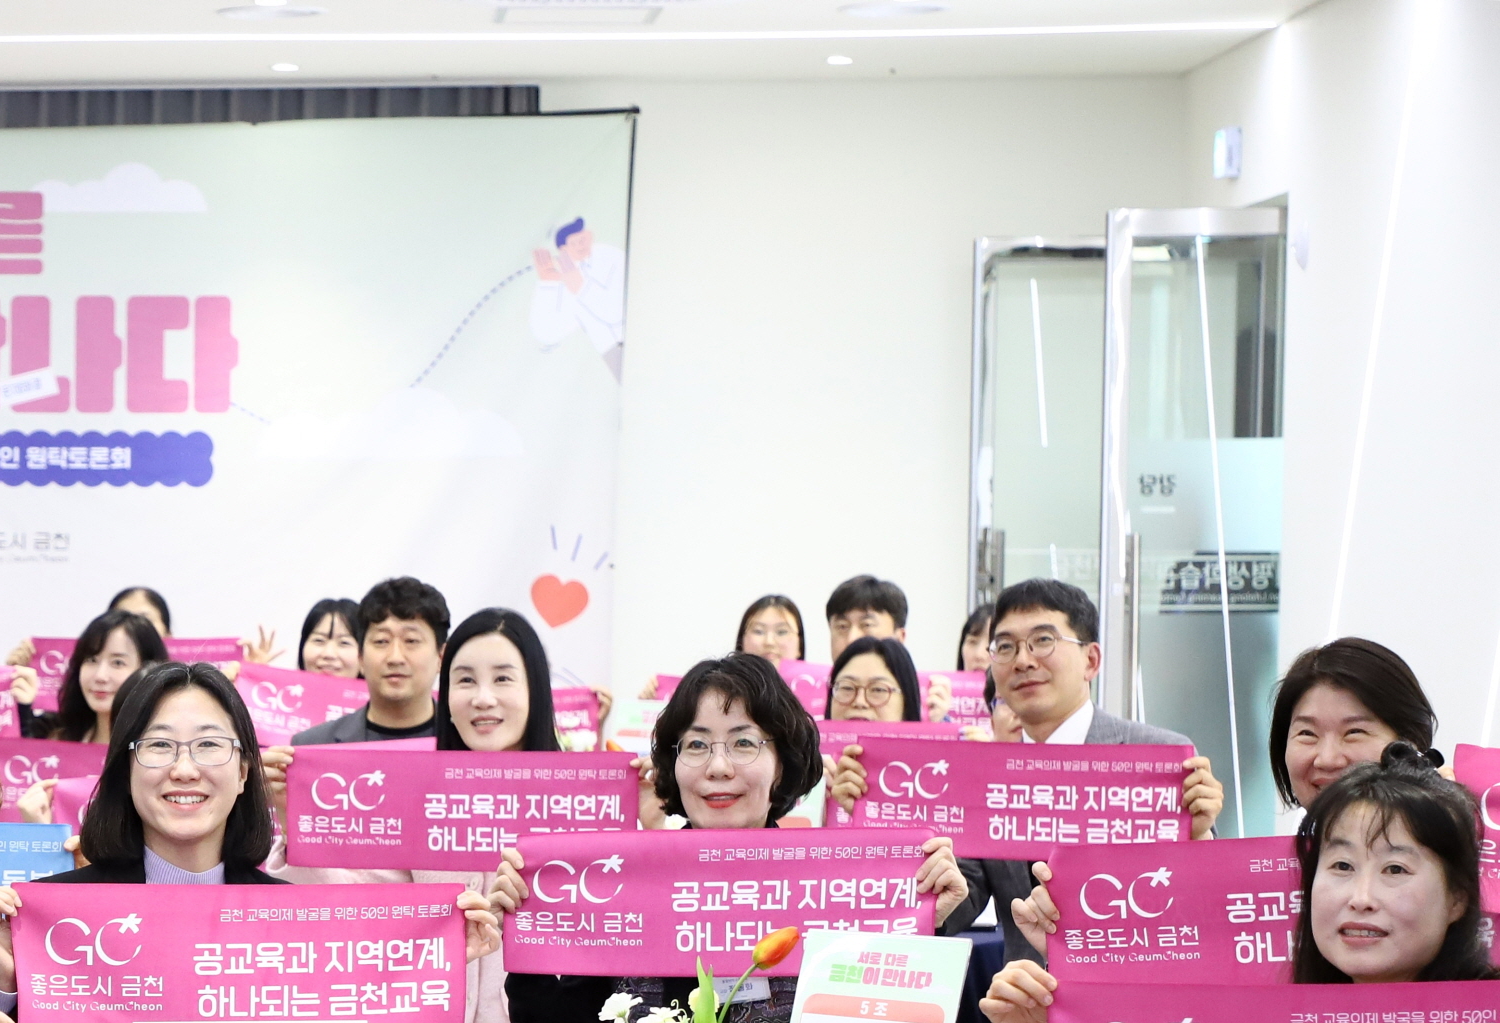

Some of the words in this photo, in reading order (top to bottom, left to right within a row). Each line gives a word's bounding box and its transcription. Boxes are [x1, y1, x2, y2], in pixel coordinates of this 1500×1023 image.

[26, 446, 132, 470] 원탁토론회
[33, 532, 70, 550] 금천
[311, 770, 386, 811] GC
[878, 760, 949, 799] GC
[424, 795, 519, 820] 공교육과
[525, 795, 624, 822] 지역연계,
[986, 785, 1078, 811] 공교육과
[1084, 786, 1181, 813] 지역연계,
[865, 802, 927, 821] 좋은도시
[934, 804, 964, 823] 금천
[298, 817, 363, 834] 좋은도시
[369, 818, 401, 835] 금천
[989, 817, 1080, 843] 하나되는
[1087, 819, 1179, 844] 금천교육
[532, 854, 625, 903] GC
[671, 880, 791, 912] 공교육과
[798, 877, 921, 909] 지역연계,
[1080, 867, 1173, 920] GC
[220, 909, 243, 922] 금천
[246, 908, 293, 921] 교육의제
[296, 908, 330, 921] 발굴을
[334, 907, 357, 920] 위한
[360, 906, 388, 919] 50인
[391, 905, 414, 919] 원탁
[418, 904, 452, 918] 토론회
[515, 912, 595, 933] 좋은도시
[603, 913, 642, 933] 금천
[45, 913, 142, 965] GC
[1064, 929, 1149, 949] 좋은도시
[1157, 926, 1199, 947] 금천
[193, 941, 316, 974] 공교육과
[324, 937, 451, 971] 지역연계,
[857, 952, 880, 965] 서로
[884, 953, 908, 967] 다른
[30, 974, 112, 996] 좋은도시
[121, 975, 163, 997] 금천
[829, 964, 879, 985] 금천이
[882, 968, 932, 989] 만나다
[198, 984, 320, 1017] 하나되는
[329, 980, 449, 1014] 금천교육
[860, 1001, 870, 1014] 5
[874, 1003, 888, 1017] 조
